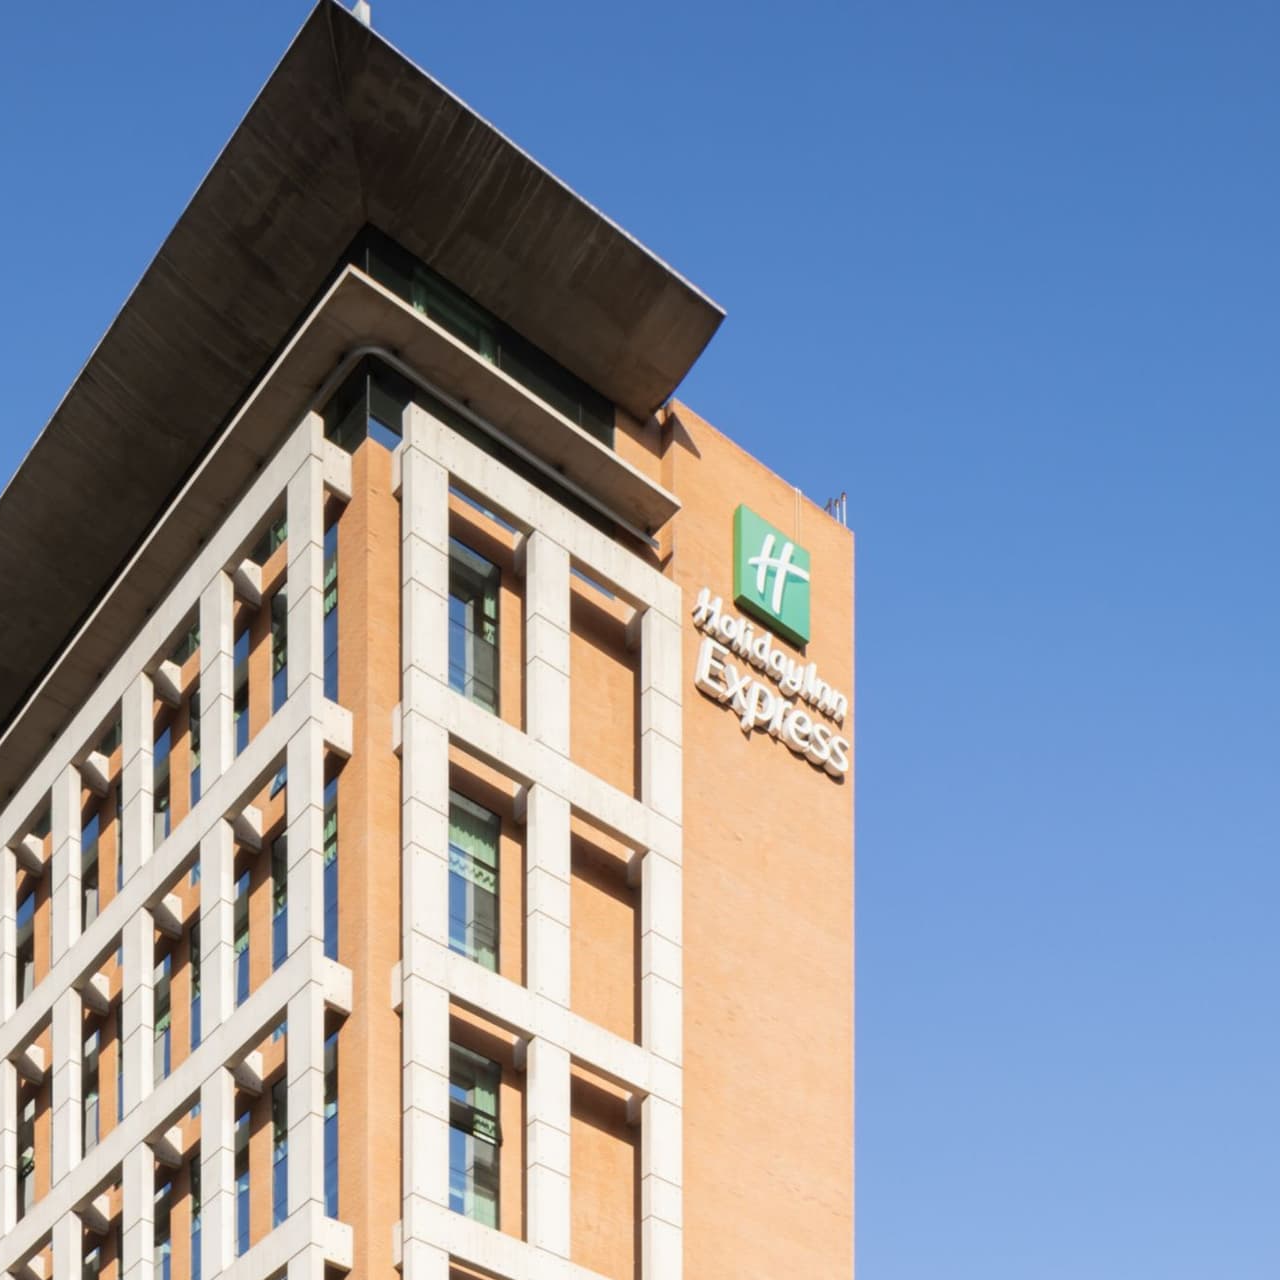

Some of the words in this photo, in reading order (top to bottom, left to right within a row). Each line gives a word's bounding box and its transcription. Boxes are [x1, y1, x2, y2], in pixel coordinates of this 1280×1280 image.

[693, 586, 805, 696] Holiday
[802, 663, 849, 722] Inn
[695, 638, 849, 776] Express
